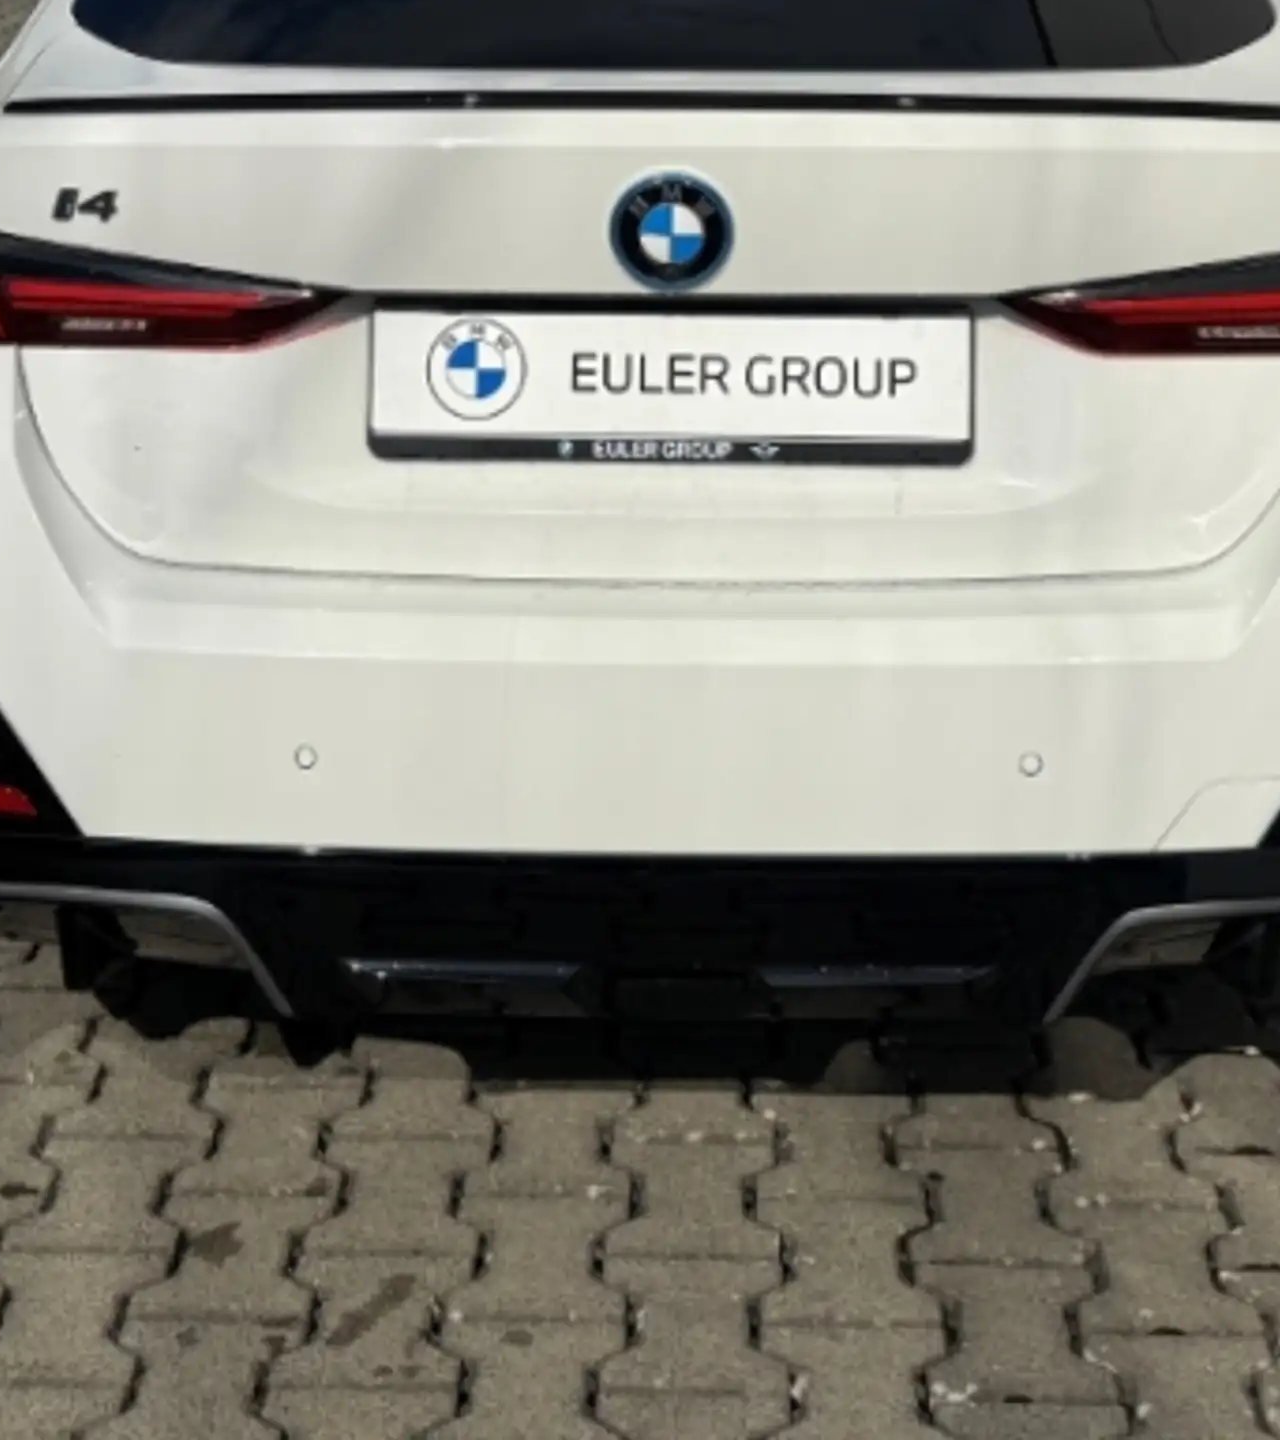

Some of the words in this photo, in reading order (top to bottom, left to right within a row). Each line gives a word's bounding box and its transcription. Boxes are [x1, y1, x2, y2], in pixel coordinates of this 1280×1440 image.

[571, 352, 731, 395] EULER
[744, 354, 919, 399] GROUP
[592, 440, 657, 458] EULER
[661, 440, 734, 459] GROUP
